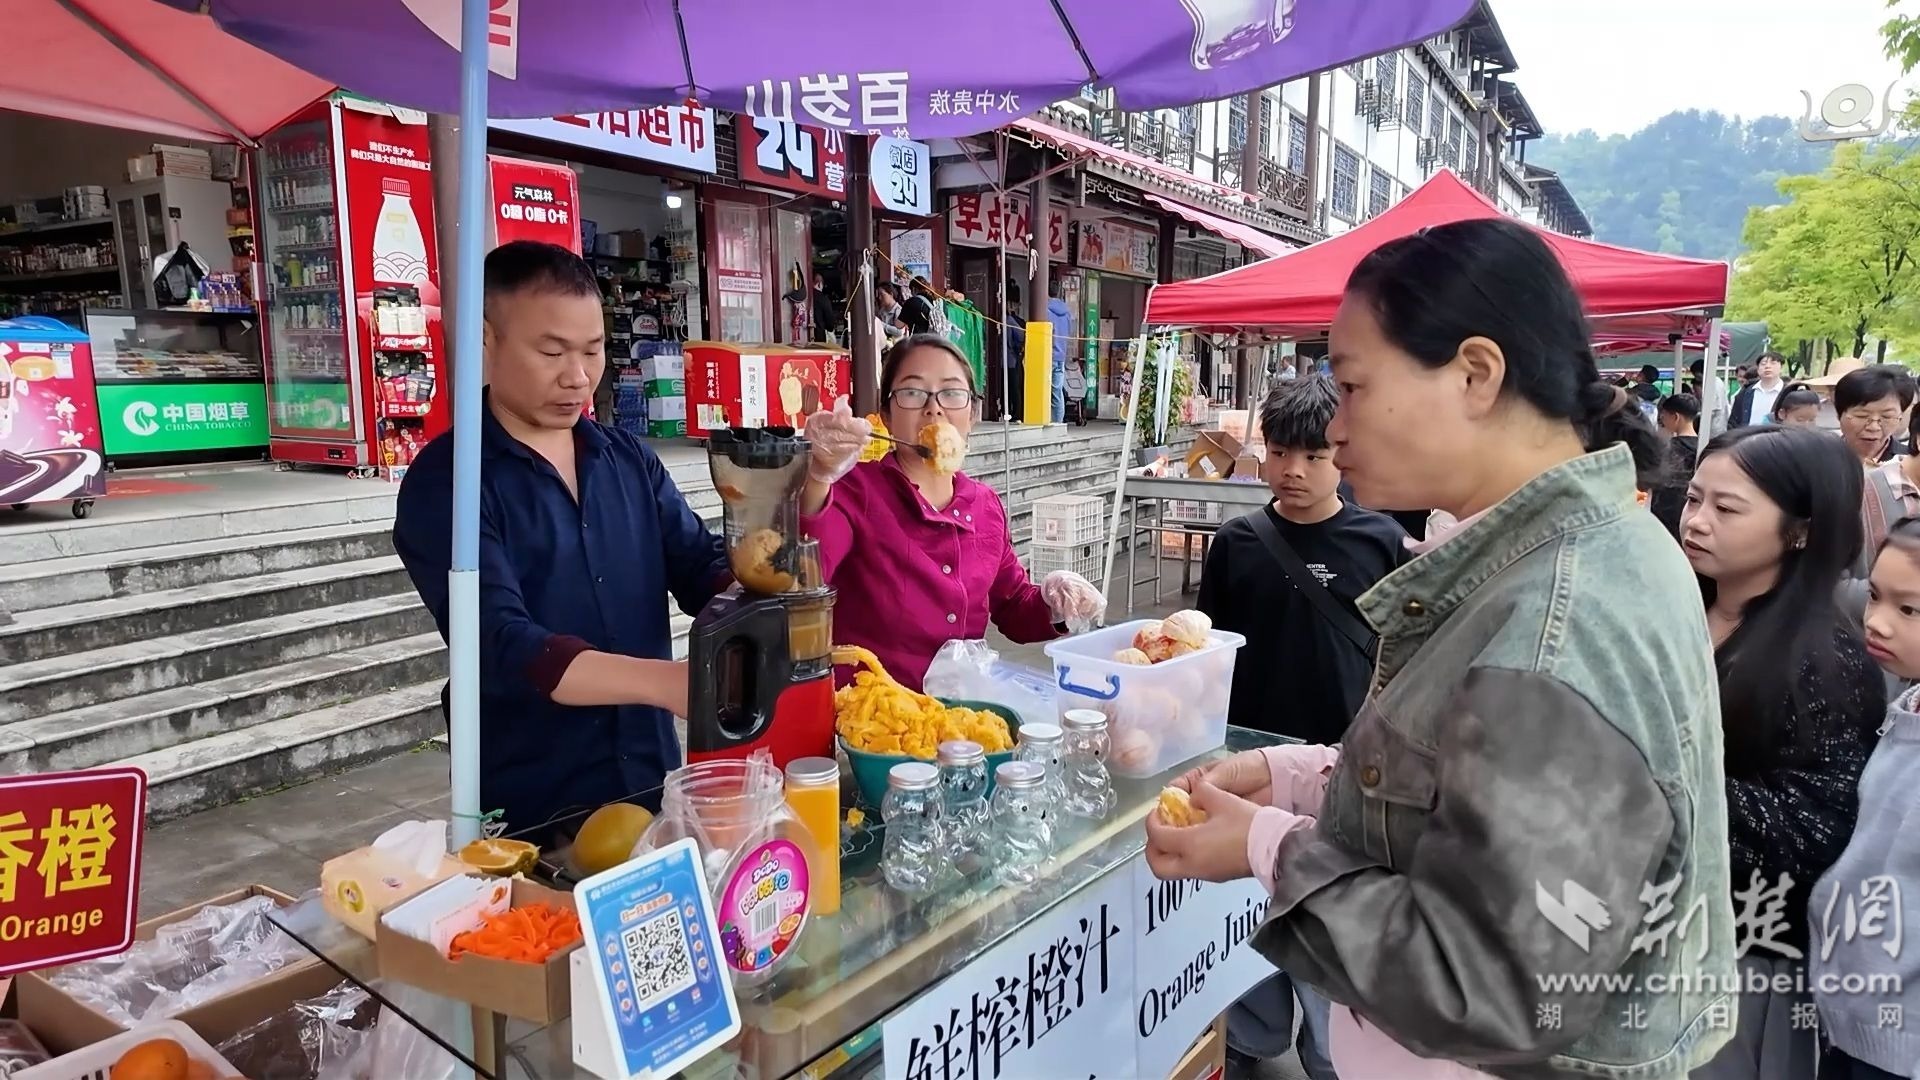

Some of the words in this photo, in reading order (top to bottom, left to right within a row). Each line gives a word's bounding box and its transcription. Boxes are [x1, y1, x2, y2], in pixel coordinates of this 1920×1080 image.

[553, 98, 705, 153] 超市
[752, 116, 818, 184] 24
[514, 186, 554, 203] 元气森林
[890, 171, 918, 208] 24
[162, 401, 250, 424] 中国烟草
[165, 423, 201, 432] CHINA
[205, 420, 252, 430] TOBACCO
[0, 908, 104, 942] Orange
[905, 903, 1121, 1080] 鲜榨橙汁
[1138, 940, 1216, 1038] Orange
